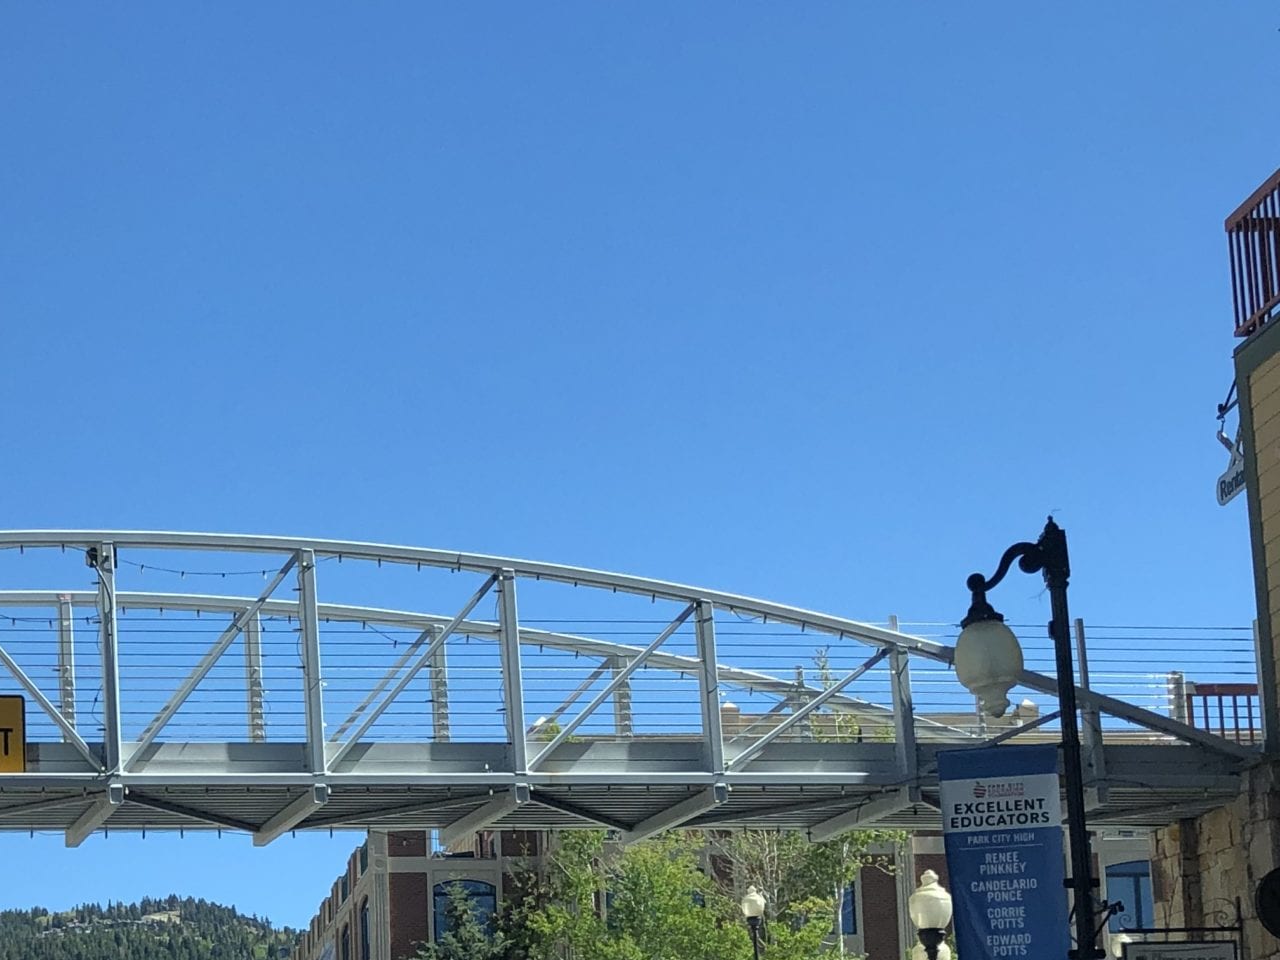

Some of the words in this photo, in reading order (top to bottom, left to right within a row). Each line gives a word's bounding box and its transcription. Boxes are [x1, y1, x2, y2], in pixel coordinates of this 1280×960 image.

[954, 798, 1045, 815] EXCELLENT
[950, 811, 1050, 828] EDUCATORS
[967, 835, 987, 845] PARK
[992, 833, 1011, 843] CITY
[1013, 832, 1035, 842] HIGH
[985, 851, 1019, 864] RENEE
[980, 862, 1026, 875] PINKNEY
[970, 878, 1037, 892] CANDELARIO
[987, 890, 1023, 903] PONCE
[987, 906, 1026, 919] CORRIE
[990, 917, 1025, 930] POTTS
[986, 933, 1032, 946] EDWARD
[993, 945, 1027, 957] POTTS
